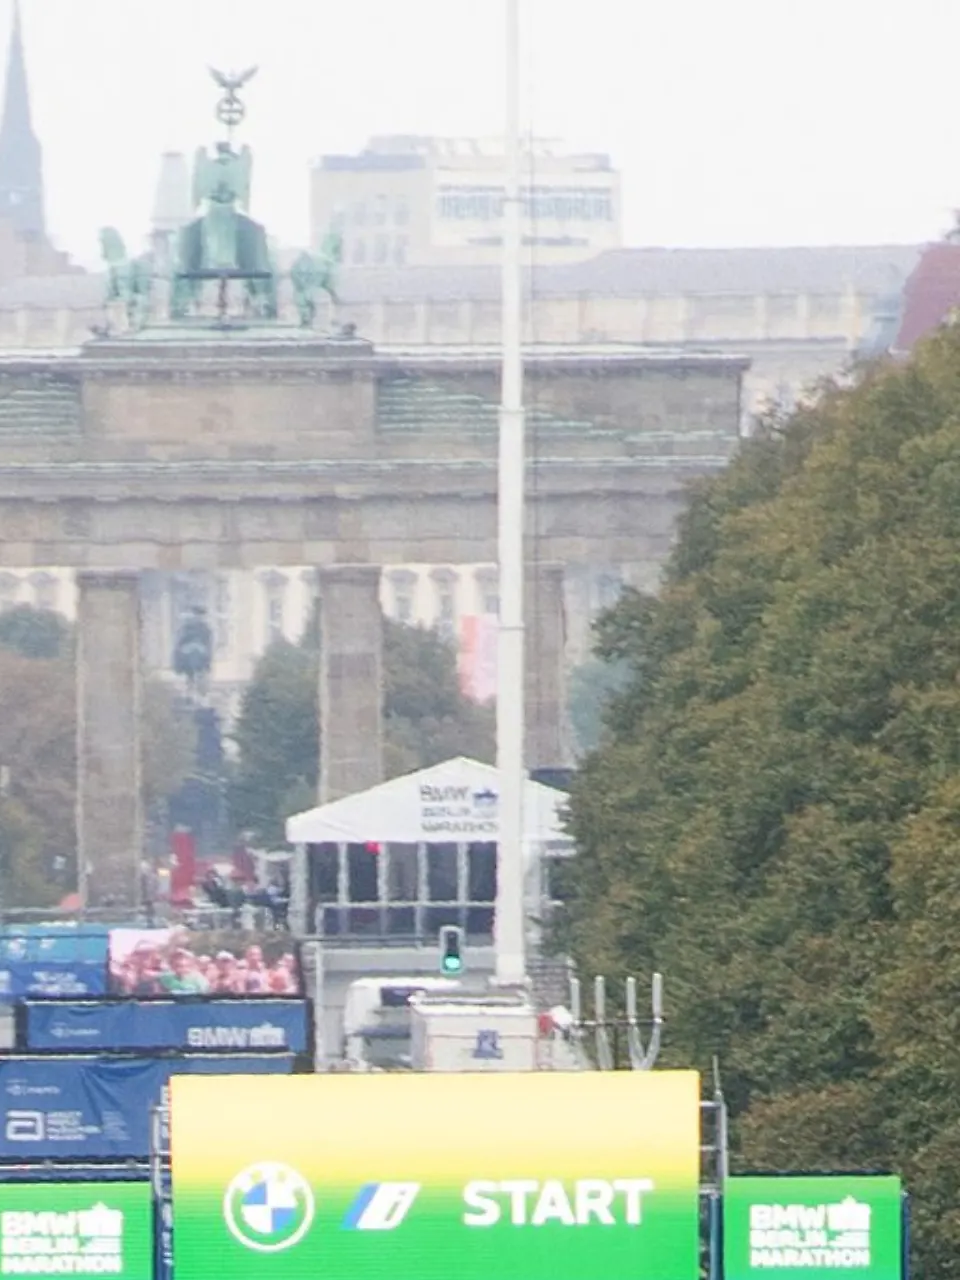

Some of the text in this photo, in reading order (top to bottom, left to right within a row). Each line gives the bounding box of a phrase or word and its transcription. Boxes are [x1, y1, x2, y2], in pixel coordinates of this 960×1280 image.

[187, 1026, 248, 1047] BMW
[463, 1178, 653, 1225] START
[0, 1211, 76, 1237] BMW
[750, 1204, 825, 1230] BMW
[0, 1255, 122, 1273] MARATHON
[750, 1248, 870, 1267] MARATHON
